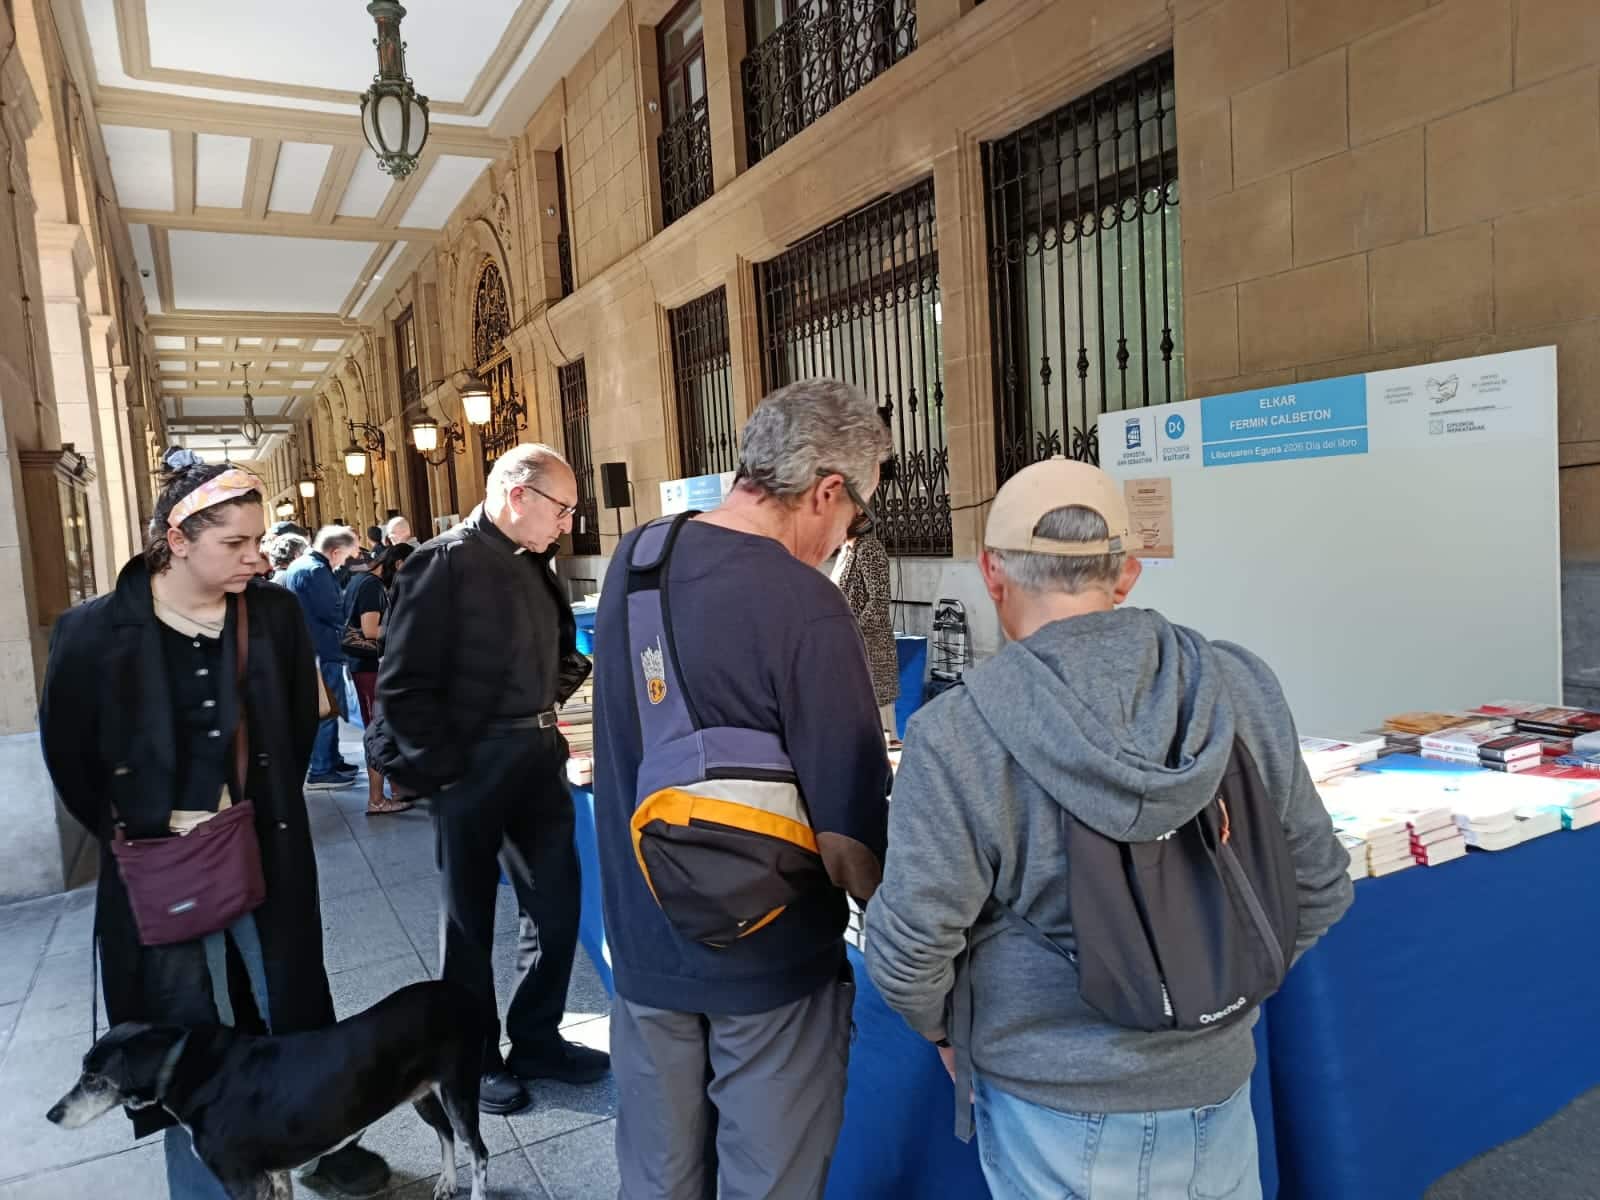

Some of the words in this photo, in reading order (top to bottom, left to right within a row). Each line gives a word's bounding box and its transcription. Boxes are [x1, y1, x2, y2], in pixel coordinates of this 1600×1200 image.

[1259, 394, 1297, 409] ELKAR
[1229, 416, 1268, 431] FERMIN
[1270, 408, 1332, 426] CALBETON
[1255, 445, 1282, 457] Eguna
[1322, 438, 1336, 449] del
[1337, 437, 1358, 449] libro
